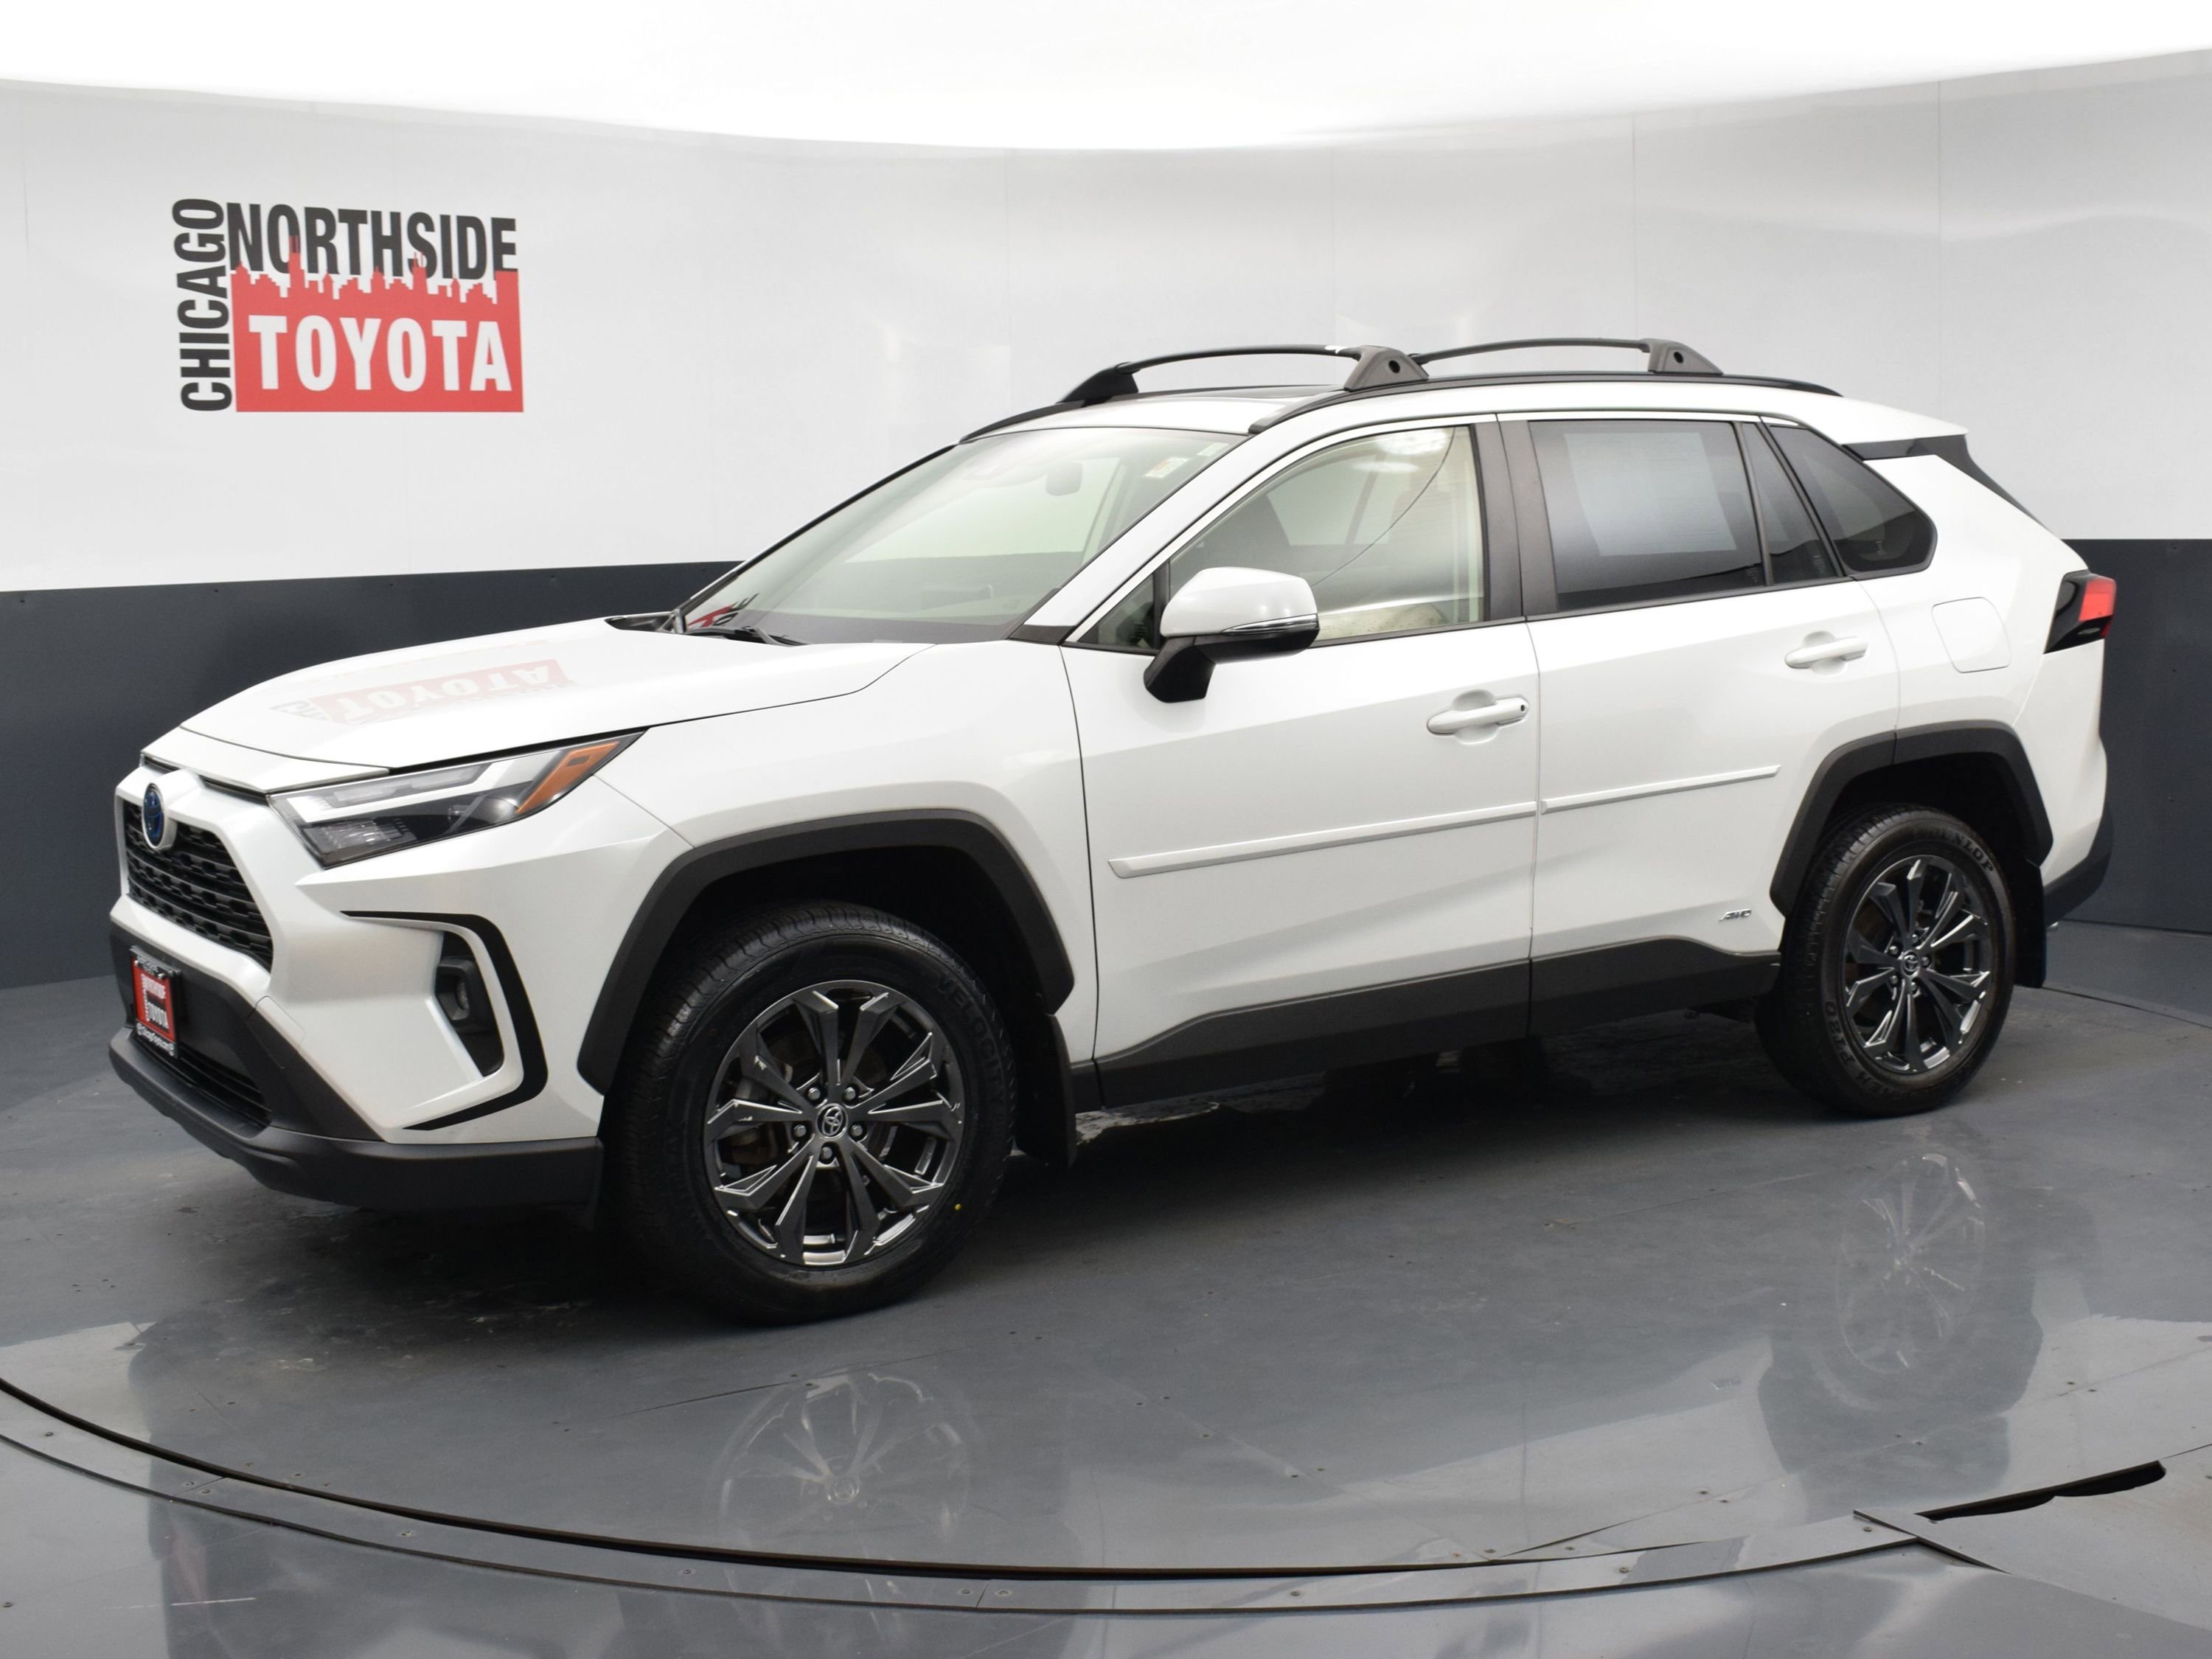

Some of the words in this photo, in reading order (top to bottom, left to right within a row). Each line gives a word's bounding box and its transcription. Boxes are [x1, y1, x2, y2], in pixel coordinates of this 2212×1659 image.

[226, 202, 518, 280] NORTHSIDE
[172, 198, 232, 411] CHICAGO
[248, 315, 512, 392] TOYOTA
[1930, 827, 1994, 872] NLOP
